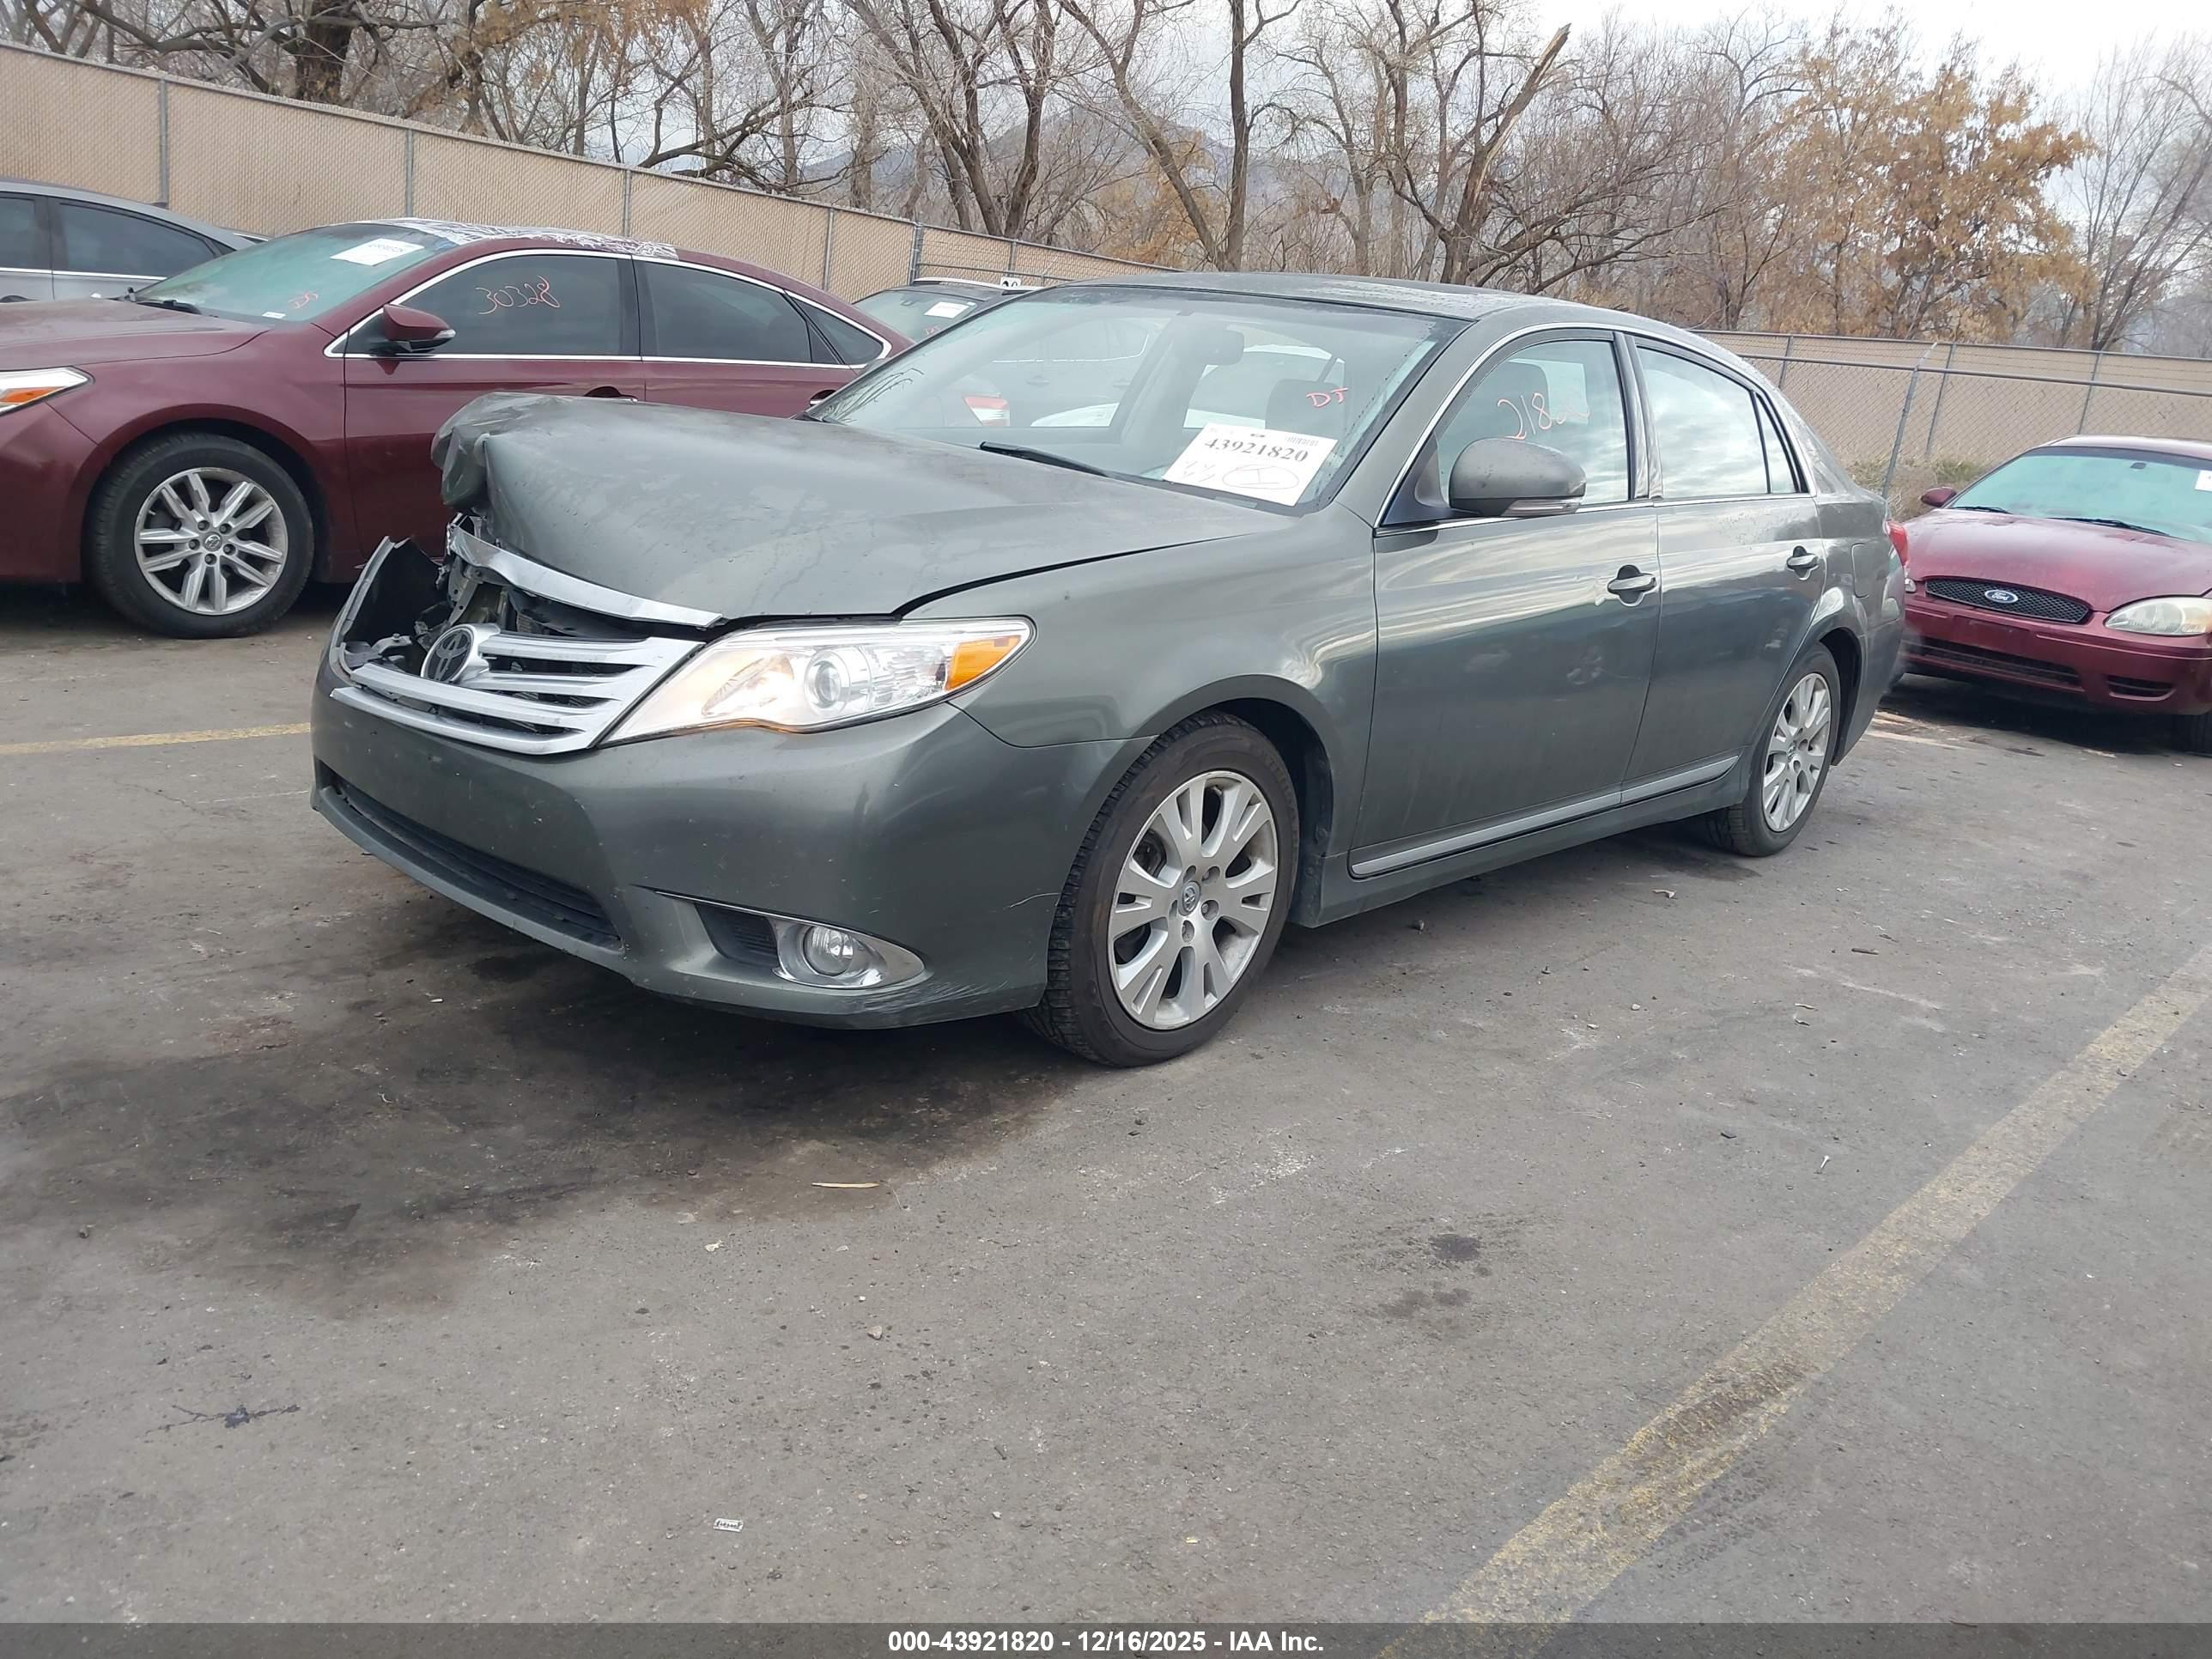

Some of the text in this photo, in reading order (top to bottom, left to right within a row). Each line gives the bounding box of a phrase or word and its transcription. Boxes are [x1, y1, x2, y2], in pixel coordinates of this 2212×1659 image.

[475, 275, 561, 314] 30328
[1305, 387, 1349, 408] DT
[1204, 438, 1310, 463] 43921820
